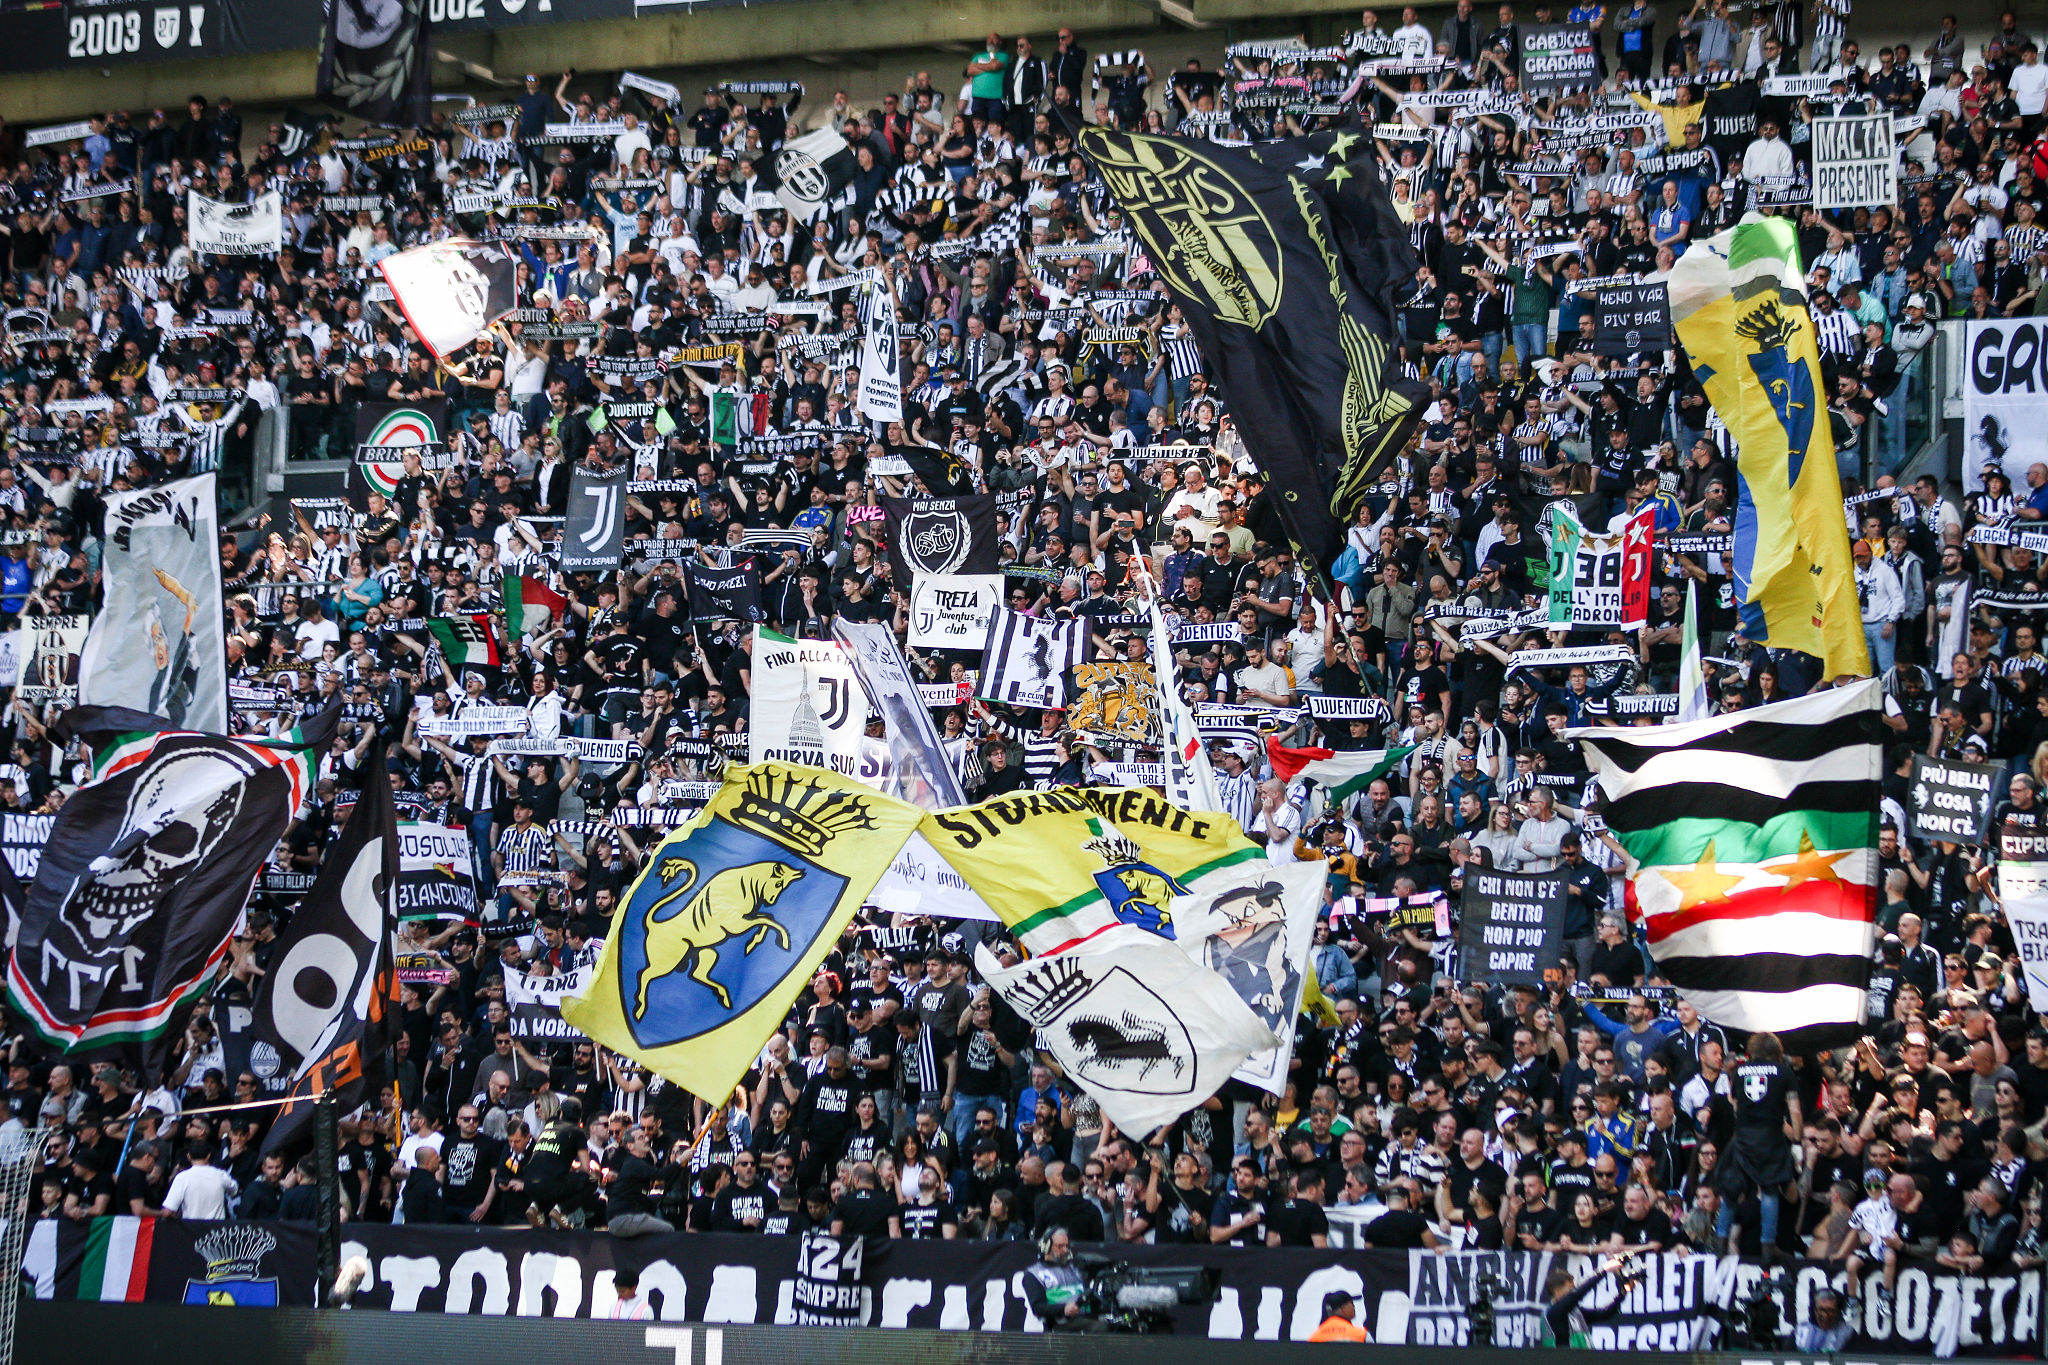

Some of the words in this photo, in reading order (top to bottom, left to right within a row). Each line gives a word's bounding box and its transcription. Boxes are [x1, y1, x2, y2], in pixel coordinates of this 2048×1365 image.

[69, 10, 141, 57] 2003
[1351, 35, 1405, 53] JUVENTUS
[1230, 45, 1251, 58] FINO
[1252, 47, 1272, 58] ALLA
[1525, 53, 1595, 73] GRADARA
[1532, 73, 1554, 81] GRUPPO
[1417, 93, 1480, 107] CINGOLI
[525, 136, 589, 147] JUVENTUS
[1546, 139, 1559, 149] OUR
[1560, 137, 1577, 148] TEAM,
[1578, 135, 1592, 147] ONE
[1593, 133, 1610, 144] CLUB
[1817, 119, 1890, 161] MALTA
[365, 139, 430, 162] JUVENTUS
[1512, 162, 1531, 172] FINO
[1553, 162, 1571, 172] FINE
[1640, 156, 1664, 174] OUR
[1819, 164, 1892, 204] PRESENTE
[456, 193, 511, 212] JUVENTUS
[1140, 290, 1156, 300] FINE
[1638, 288, 1664, 302] VAR
[504, 308, 548, 322] JUVENTUS
[1634, 309, 1661, 326] BAR
[705, 319, 718, 330] OUR
[718, 318, 736, 329] TEAM,
[737, 318, 749, 328] ONE
[750, 316, 765, 327] CLUB
[901, 323, 917, 334] FINE
[1087, 328, 1139, 341] JUVENTUS
[682, 348, 701, 361] FINO
[703, 346, 724, 360] ALLA
[1972, 322, 2048, 396] GR
[599, 361, 610, 371] OUR
[611, 361, 627, 372] TEAM,
[628, 361, 639, 371] ONE
[640, 360, 656, 371] CLUB
[608, 402, 655, 417] JUVENTUS
[1129, 447, 1183, 458] JUVENTUS
[1186, 447, 1200, 457] FC
[626, 484, 689, 494] FIGHTERS
[1005, 491, 1018, 503] CLUB
[913, 502, 927, 512] MAI
[929, 500, 956, 511] SENZA
[1970, 527, 2007, 542] BLACK
[633, 540, 641, 549] DI
[643, 540, 666, 549] PADRE
[667, 540, 674, 548] IN
[675, 539, 697, 548] FIGLIO
[645, 549, 664, 558] SINCE
[665, 549, 682, 558] 1897
[562, 557, 582, 566] NON
[583, 557, 591, 566] CI
[592, 556, 618, 566] SEPARI
[1574, 551, 1622, 588] 38
[718, 574, 747, 590] PAZZI
[936, 608, 975, 622] Juventus
[1439, 605, 1465, 616] FINO
[1563, 606, 1629, 623] PADRONI
[31, 615, 79, 630] SEMPRE
[944, 623, 967, 635] club
[1470, 620, 1502, 636] FORZA
[764, 651, 795, 669] FINO
[800, 649, 831, 663] ALLA
[1547, 651, 1566, 661] FINO
[1568, 650, 1591, 660] ALLA
[1593, 648, 1614, 659] FINE
[22, 687, 62, 699] INSIEME
[1029, 690, 1046, 701] CLUB
[482, 706, 505, 719] ALLA
[506, 705, 525, 718] FINE
[1313, 698, 1375, 716] JUVENTUS
[1615, 697, 1678, 714] JUVENTUS
[439, 722, 462, 733] FINO
[463, 722, 486, 733] ALLA
[488, 720, 507, 732] FINE
[498, 740, 516, 752] FINO
[518, 740, 537, 752] ALLA
[540, 739, 557, 751] FINE
[721, 732, 750, 746] JUVE
[675, 741, 712, 755] #FINOA
[1536, 775, 1576, 786] JUVENTUS
[1921, 764, 1947, 785] PIÙ
[1948, 769, 1990, 791] BELLA
[1933, 791, 1973, 813] COSA
[586, 805, 605, 816] Jeep
[1917, 812, 1951, 835] NON
[266, 874, 284, 888] FINO
[286, 873, 304, 887] ALLA
[1478, 875, 1502, 895] CHI
[1505, 877, 1534, 898] NON
[1403, 911, 1410, 924] DI
[1490, 901, 1543, 923] DENTRO
[871, 926, 917, 949] YILDIZ
[1483, 926, 1513, 946] NON
[1489, 951, 1535, 972] CAPIRE
[519, 972, 536, 990] TI
[543, 972, 579, 993] AMO
[1604, 987, 1634, 999] FORZA
[510, 1018, 528, 1037] DA
[816, 1098, 847, 1113] STORICO
